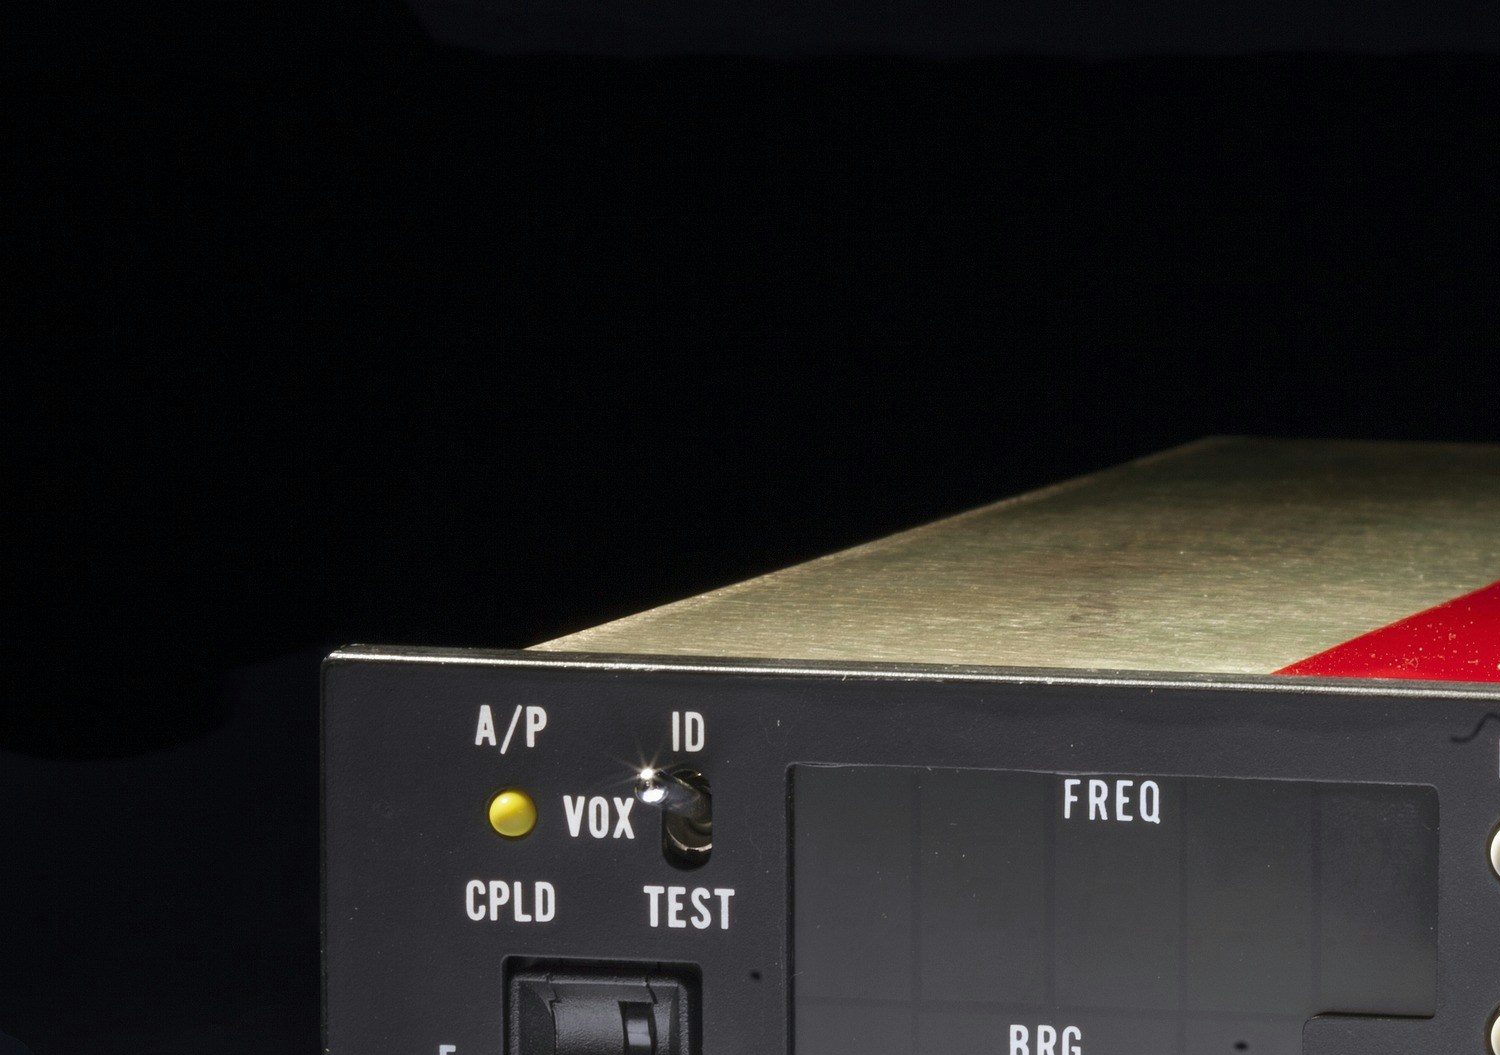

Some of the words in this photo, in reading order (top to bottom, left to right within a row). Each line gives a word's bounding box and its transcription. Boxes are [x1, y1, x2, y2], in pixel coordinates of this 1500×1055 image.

[474, 704, 548, 755] A/P
[671, 710, 705, 753] ID
[562, 794, 635, 840] VOX
[1064, 778, 1161, 825] FREQ
[465, 879, 556, 923] CPLD
[643, 885, 736, 930] TEST
